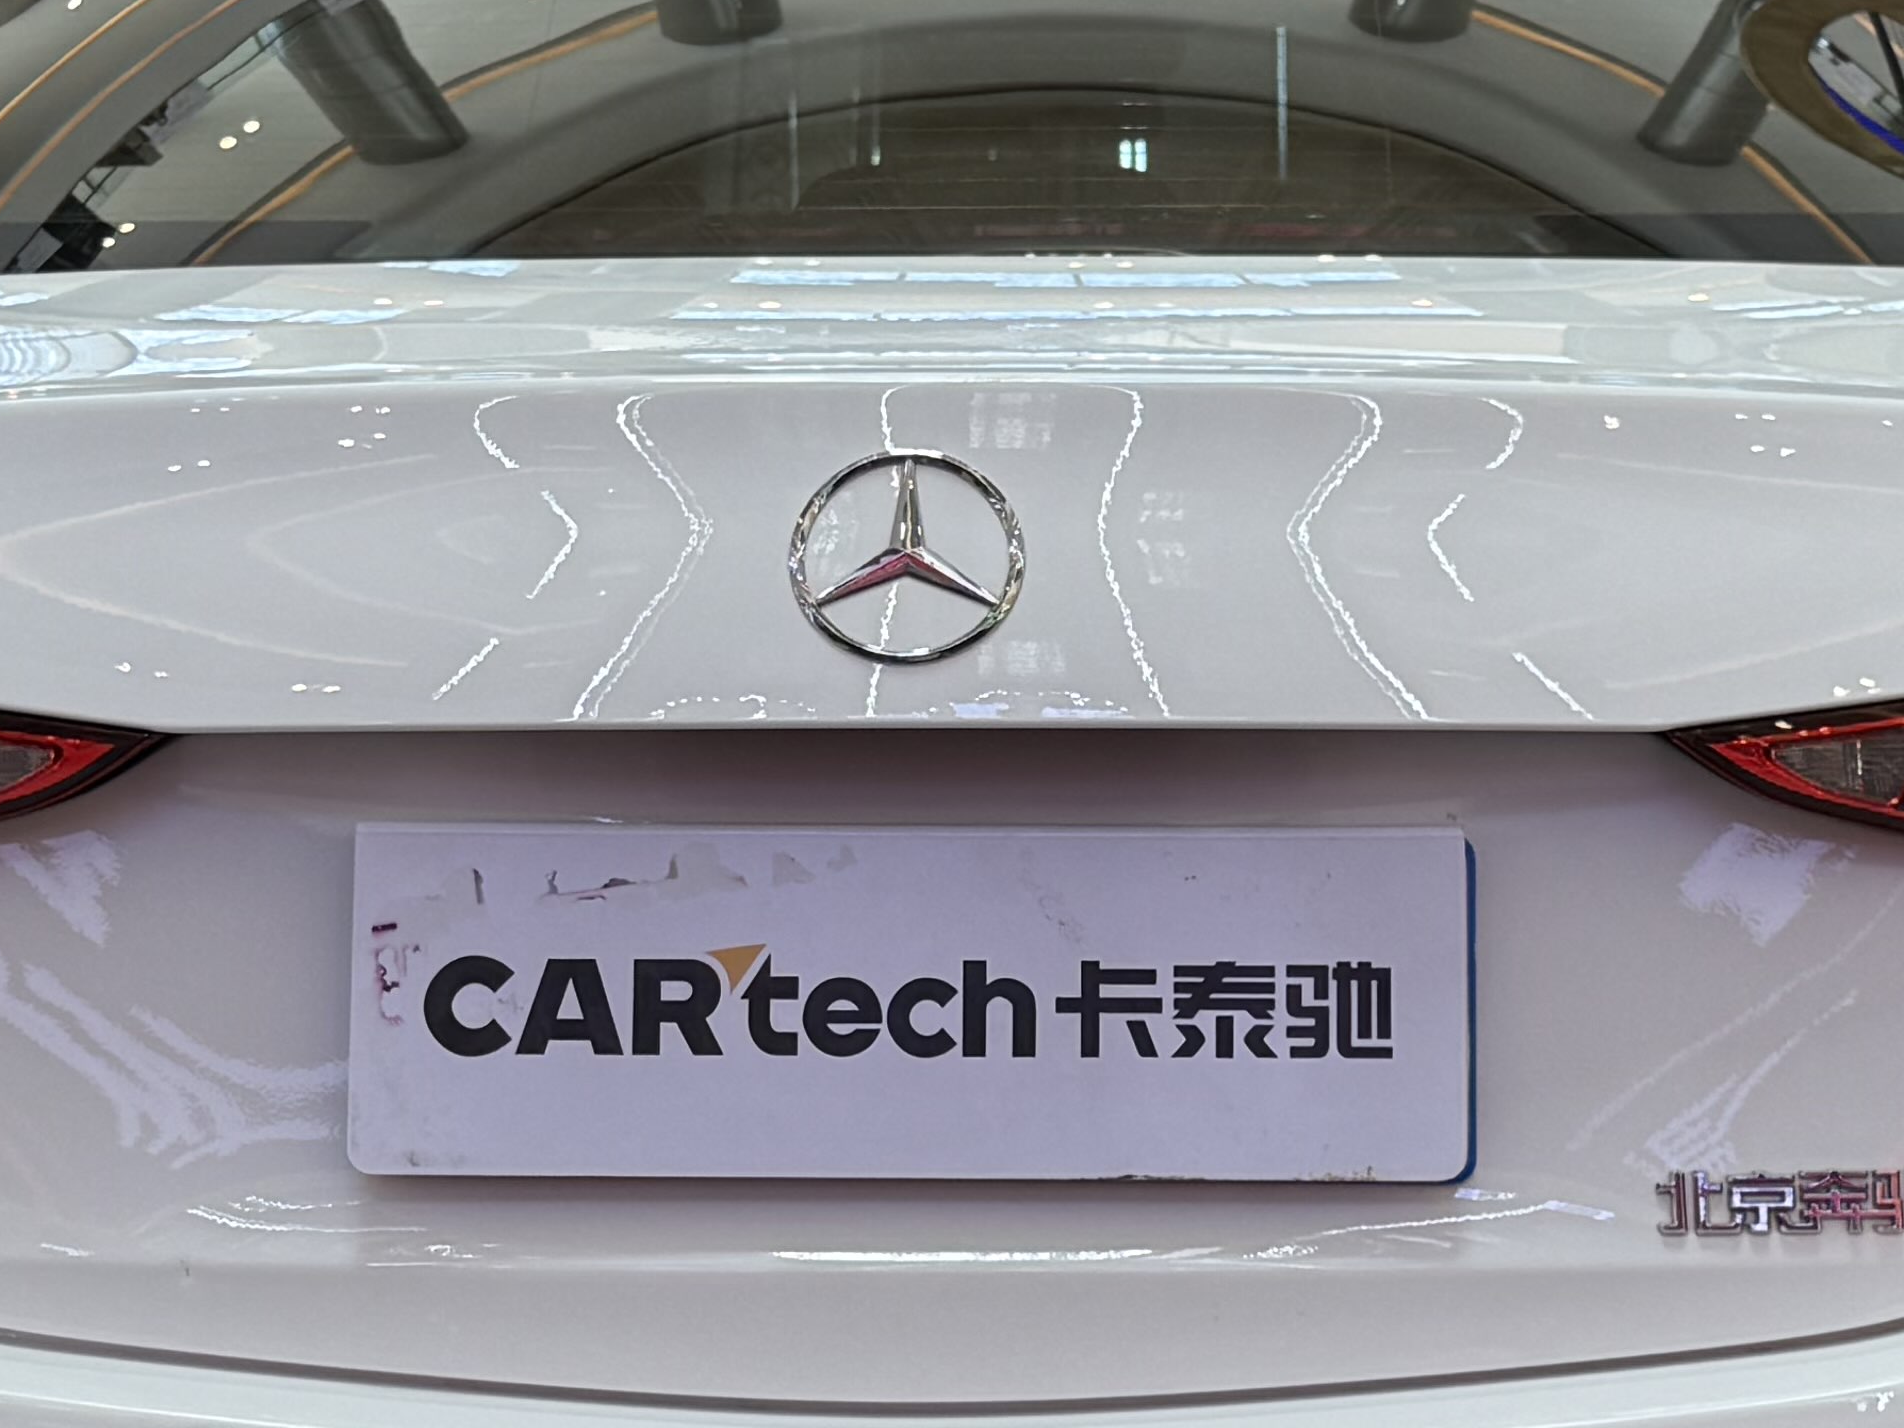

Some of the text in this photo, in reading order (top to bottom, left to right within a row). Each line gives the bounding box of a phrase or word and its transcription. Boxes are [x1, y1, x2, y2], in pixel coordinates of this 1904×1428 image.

[422, 948, 1395, 1061] CARtech 卡泰驰
